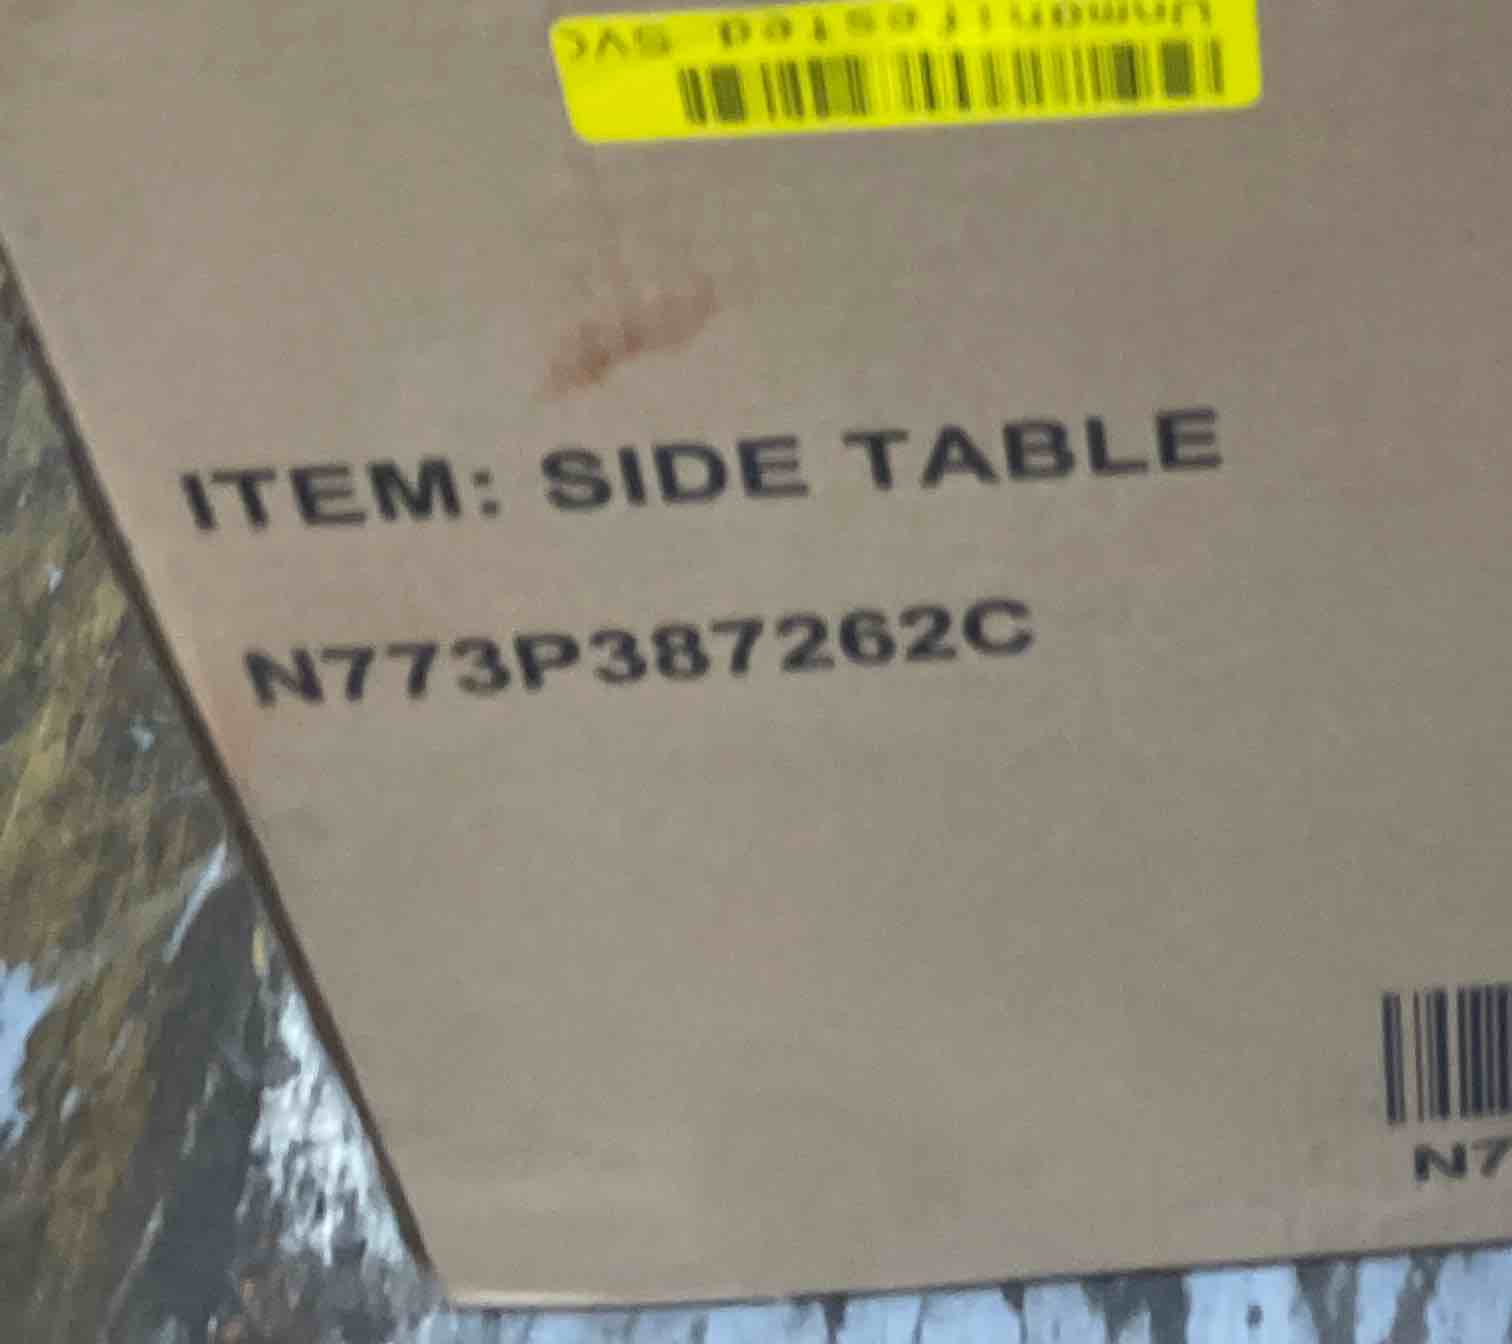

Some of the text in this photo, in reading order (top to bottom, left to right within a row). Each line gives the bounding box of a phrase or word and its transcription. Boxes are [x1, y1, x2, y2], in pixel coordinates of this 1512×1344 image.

[182, 408, 1224, 532] ITEM: SIDE TABLE
[245, 598, 1033, 709] N773P387262C
